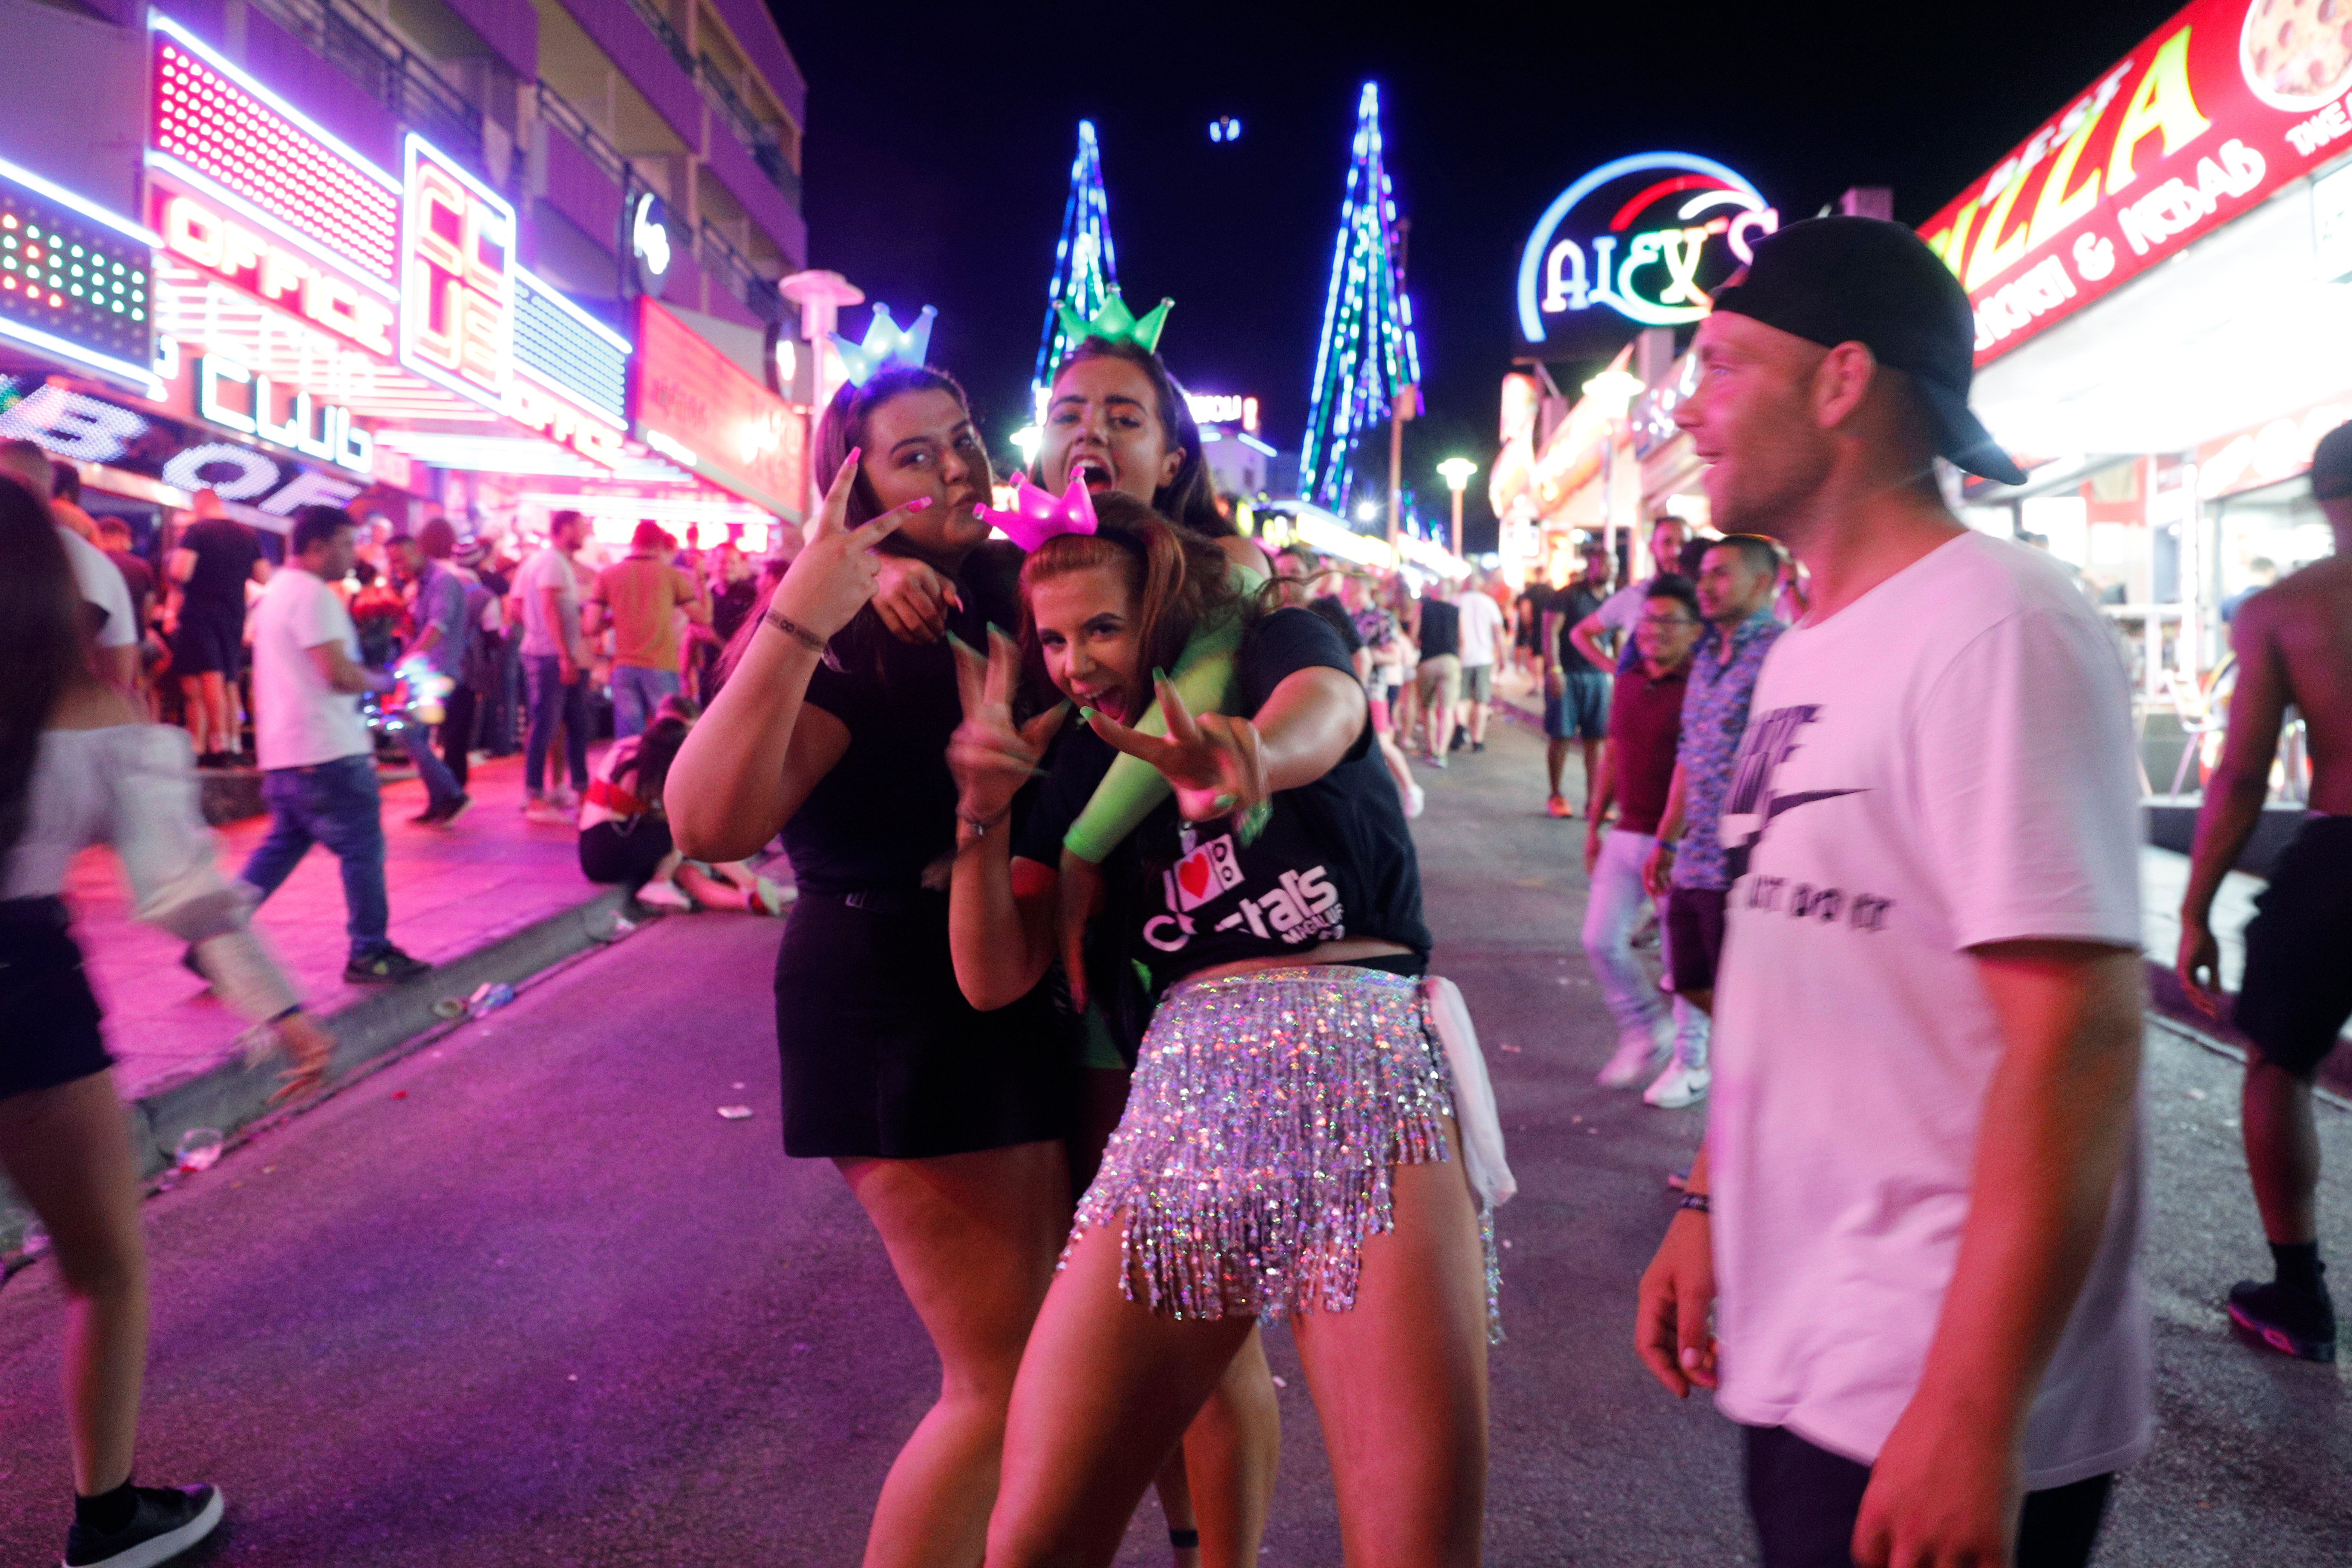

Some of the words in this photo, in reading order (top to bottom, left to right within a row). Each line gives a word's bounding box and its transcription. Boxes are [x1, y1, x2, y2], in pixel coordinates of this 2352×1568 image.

[1927, 23, 2213, 294] IZZA
[169, 196, 394, 356] OFFICE
[2072, 231, 2116, 282] &
